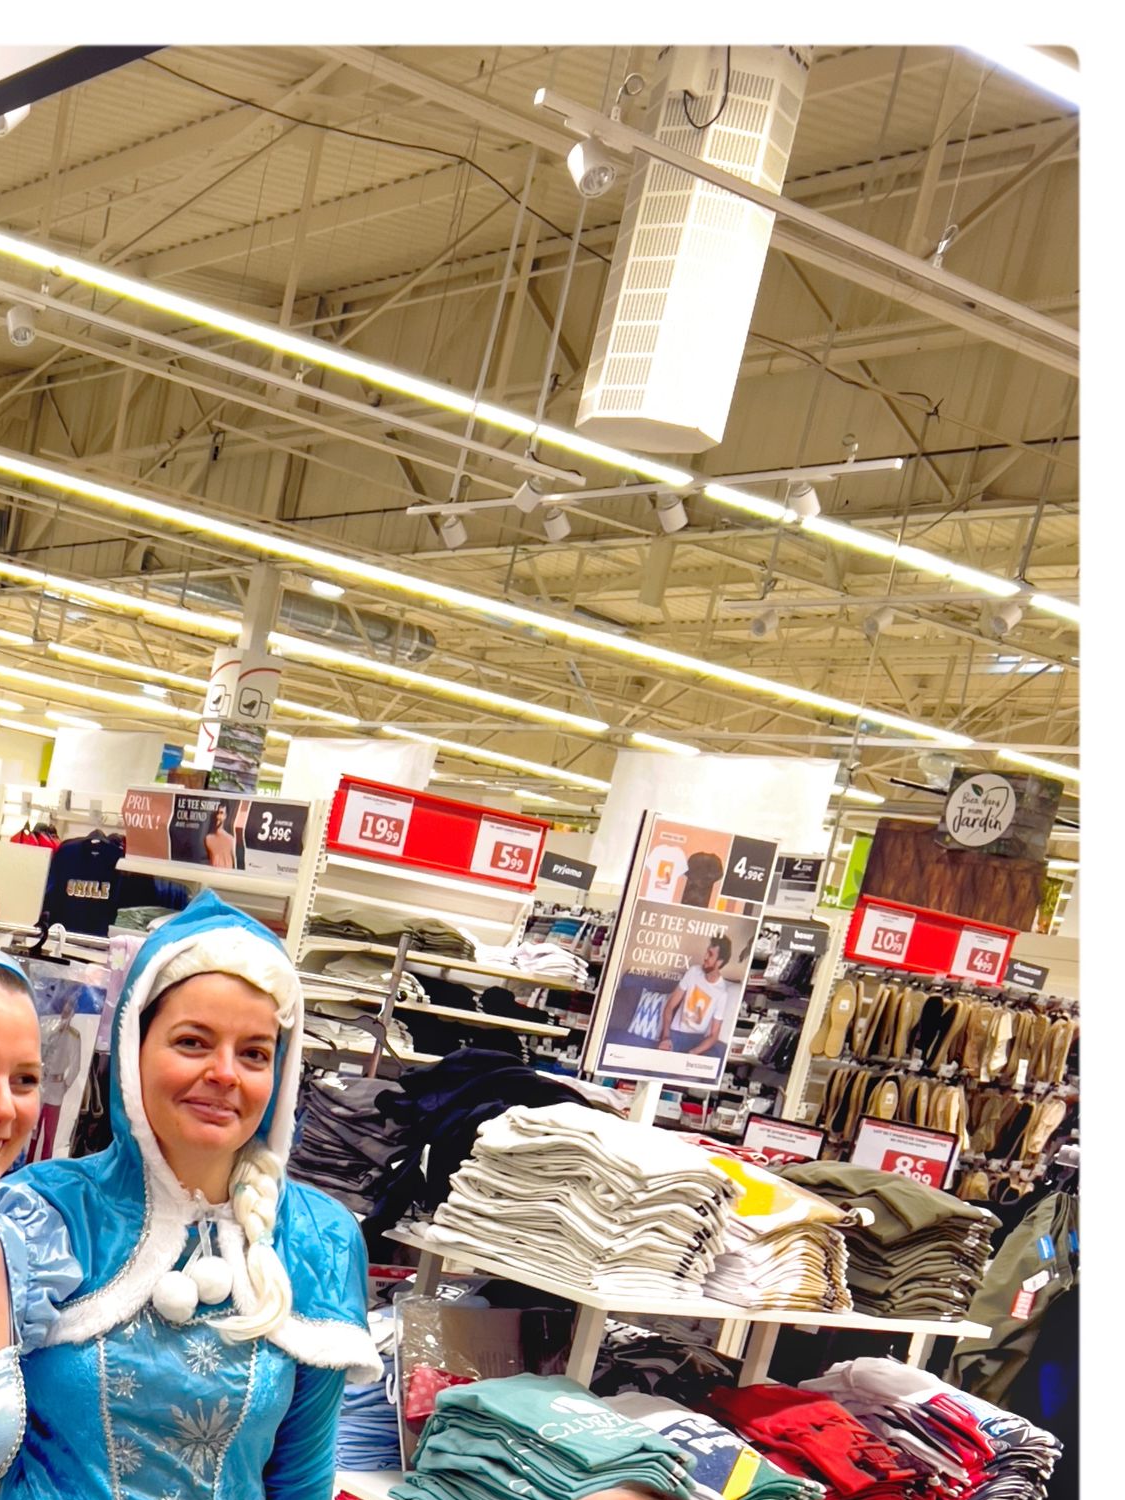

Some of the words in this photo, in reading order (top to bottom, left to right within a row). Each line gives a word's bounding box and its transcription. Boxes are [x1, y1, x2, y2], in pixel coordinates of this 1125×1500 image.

[126, 793, 153, 812] PRIX
[952, 806, 1002, 833] Jardin
[639, 910, 658, 928] LE
[659, 914, 686, 933] TEE
[686, 918, 729, 940] SHIRT
[635, 928, 683, 950] COTON
[631, 946, 693, 970] OEKOTEX
